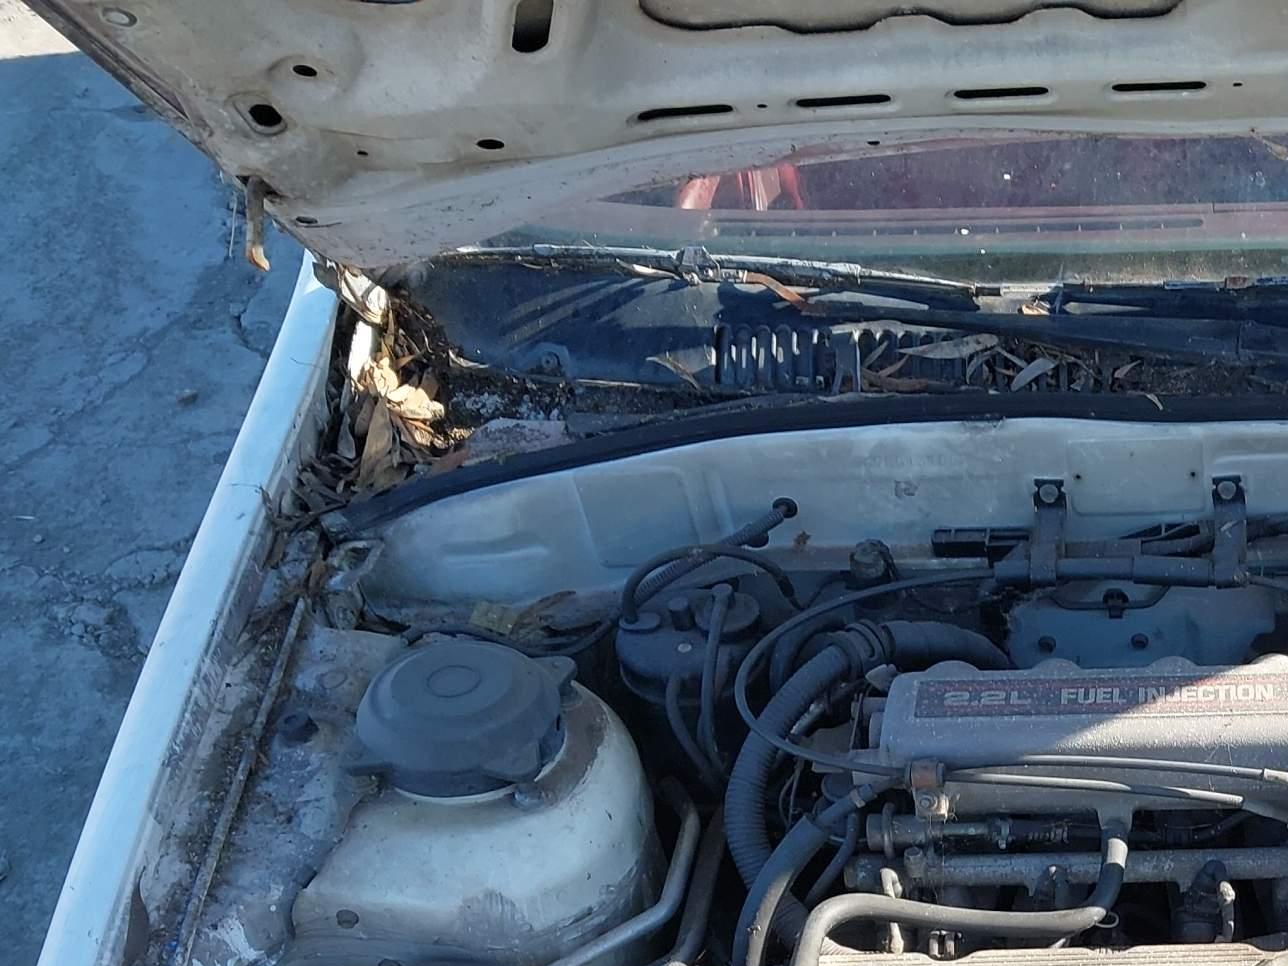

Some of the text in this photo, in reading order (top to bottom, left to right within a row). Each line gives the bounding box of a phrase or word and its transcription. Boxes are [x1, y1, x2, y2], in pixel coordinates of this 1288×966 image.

[943, 683, 1275, 706] 2.2L FUEL INJECTION
